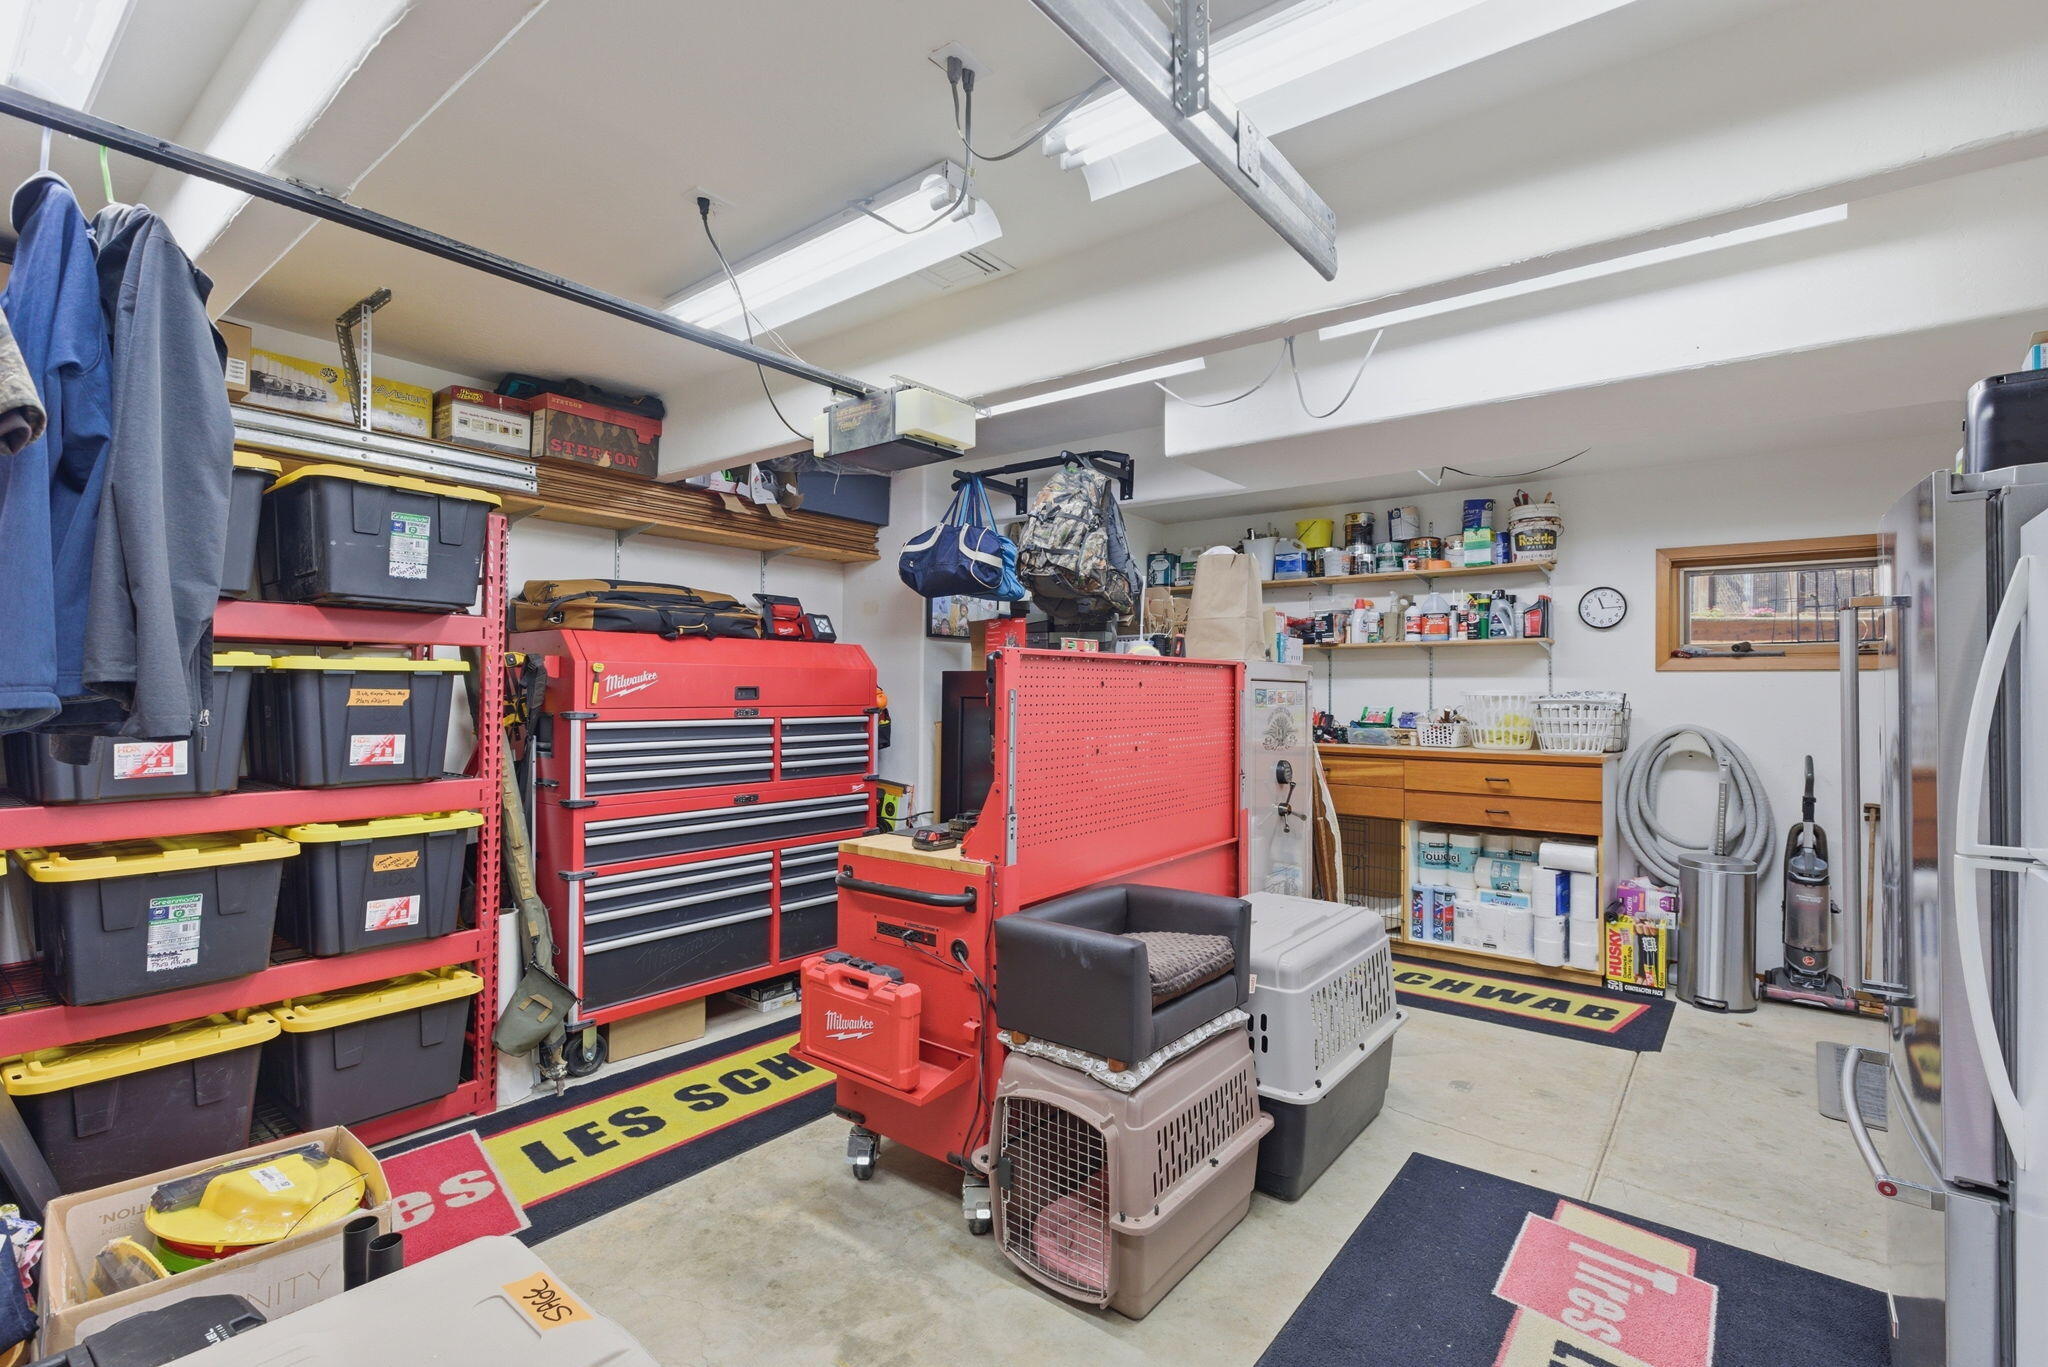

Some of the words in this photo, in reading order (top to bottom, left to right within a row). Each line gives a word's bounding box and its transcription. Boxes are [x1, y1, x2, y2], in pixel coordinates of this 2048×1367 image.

[602, 670, 658, 692] Milwaukee
[1608, 928, 1624, 977] HUSKY
[825, 1009, 874, 1031] Milwaukee
[1394, 971, 1621, 1022] CHWAB
[520, 1105, 667, 1174] LES
[673, 1052, 816, 1112] SCH
[98, 1203, 146, 1225] TION.
[391, 1169, 496, 1233] es
[246, 1263, 331, 1309] NITY
[1560, 1241, 1679, 1343] Tires
